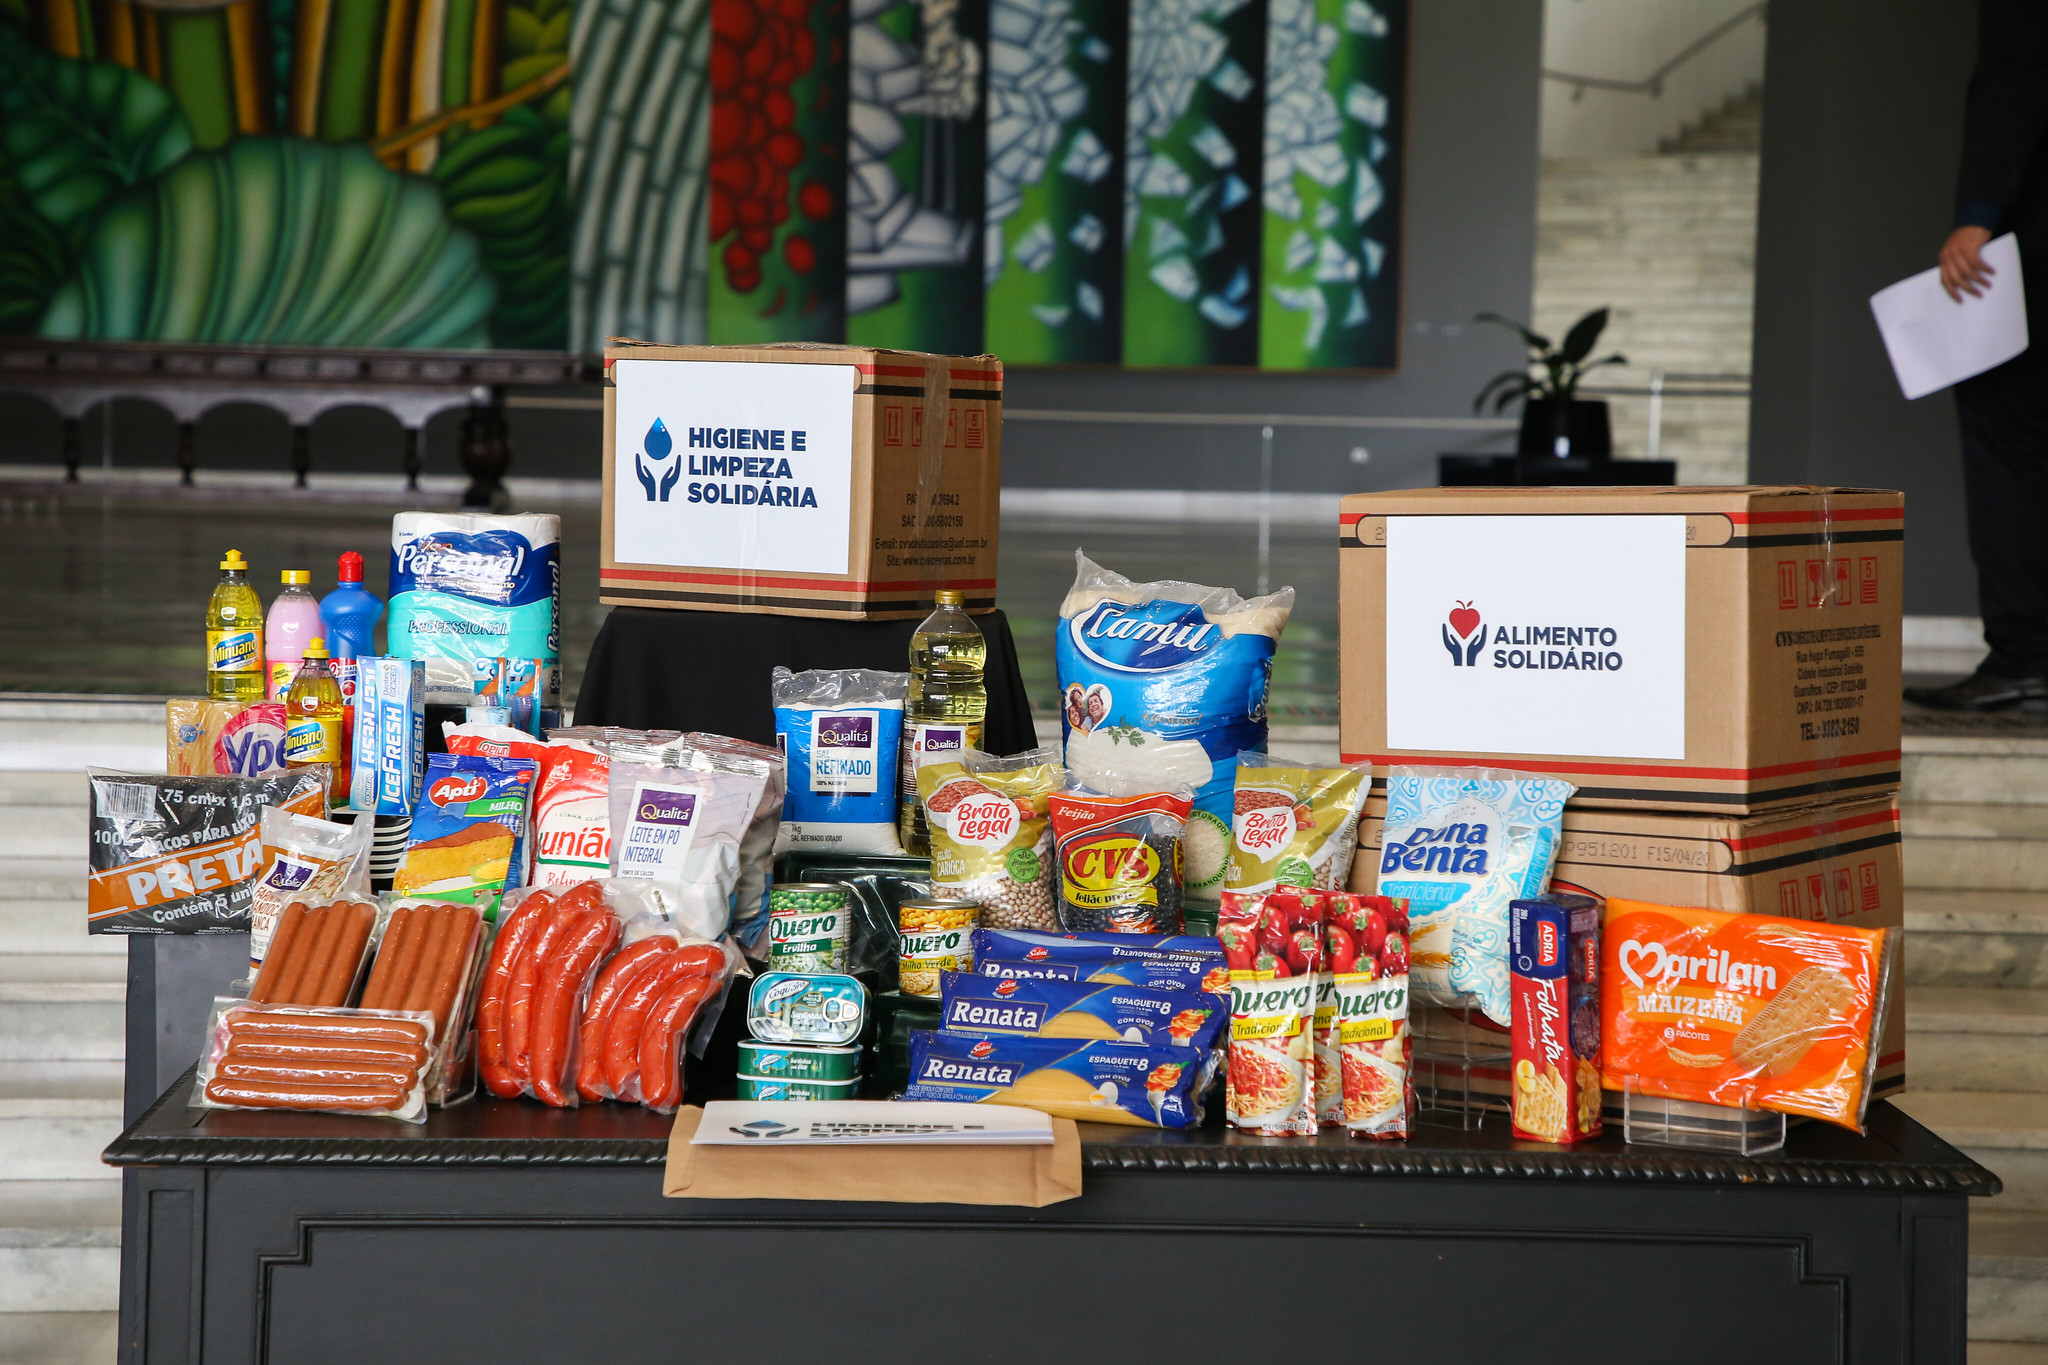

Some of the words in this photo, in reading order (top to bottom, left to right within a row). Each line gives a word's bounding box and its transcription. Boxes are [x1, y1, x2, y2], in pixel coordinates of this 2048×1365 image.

[688, 427, 785, 452] HIGIENE
[791, 430, 807, 452] E
[688, 455, 793, 479] LIMPEZA
[687, 480, 818, 508] SOLIDÁRIA
[875, 537, 898, 550] E-mail:
[886, 554, 901, 567] Site:
[1866, 561, 1873, 578] 5
[547, 560, 561, 653] Personal
[408, 620, 509, 636] PROFESSIONAL
[1087, 608, 1214, 652] Camil
[1493, 625, 1618, 648] ALIMENTO
[1775, 631, 1793, 647] CVS
[214, 639, 258, 664] Minuano
[1493, 646, 1623, 671] SOLIDÁRIO
[389, 664, 397, 698] brancos
[821, 729, 868, 745] Qualitá
[926, 738, 959, 750] Qualitá
[816, 750, 831, 758] SAL
[816, 760, 872, 776] REFINADO
[163, 788, 185, 804] 75
[434, 779, 480, 801] Apti
[488, 801, 523, 812] MILHO
[640, 803, 690, 821] Qualitá
[957, 802, 1011, 821] Broto
[1057, 806, 1096, 821] Feijão
[958, 817, 1013, 841] Legal
[1192, 810, 1229, 837] CIONADOS
[1245, 812, 1289, 829] Broto
[156, 834, 191, 852] ACOS
[192, 827, 231, 845] PARA
[231, 812, 257, 836] LIXO
[629, 826, 654, 844] LEITE
[655, 828, 666, 844] EM
[667, 826, 681, 846] PÓ
[791, 834, 800, 842] SAL
[1241, 826, 1288, 849] Legal
[1404, 823, 1489, 847] Dona
[623, 846, 664, 864] INTEGRAL
[1072, 846, 1150, 881] CVS
[1380, 842, 1490, 877] Benta
[937, 860, 966, 877] CARIOCA
[1075, 892, 1103, 905] feijão
[1388, 883, 1457, 902] Tradicional
[152, 899, 214, 924] Contém
[770, 915, 838, 943] Quero
[782, 943, 817, 954] Ervilha
[900, 932, 961, 959] Quero
[1112, 947, 1121, 956] 8
[1542, 924, 1554, 963] ADRIA
[924, 957, 952, 969] Verde
[1119, 949, 1162, 959] ESPAGUETE
[1586, 941, 1596, 980] ADRIA
[1189, 962, 1201, 974] 8
[1619, 939, 1777, 990] Marilan
[1166, 979, 1186, 990] OVOS
[1111, 996, 1162, 1010] ESPAGUETE
[1159, 1002, 1172, 1015] 8
[1637, 994, 1744, 1025] MAIZENA
[951, 1001, 1038, 1029] Renata
[1117, 1017, 1135, 1025] COM
[1135, 1018, 1155, 1028] OVOS
[1532, 977, 1565, 1066] Folhata
[1236, 1020, 1295, 1037] Tradicional
[1341, 1023, 1387, 1040] radicional
[1675, 1029, 1711, 1041] PACOTES
[790, 1057, 812, 1065] Sardinhas
[1088, 1056, 1139, 1067] ESPAGUETE
[1137, 1058, 1149, 1072] 8
[923, 1059, 1013, 1083] Renata
[1112, 1074, 1132, 1083] OVOS
[788, 1089, 810, 1097] Sardinhas
